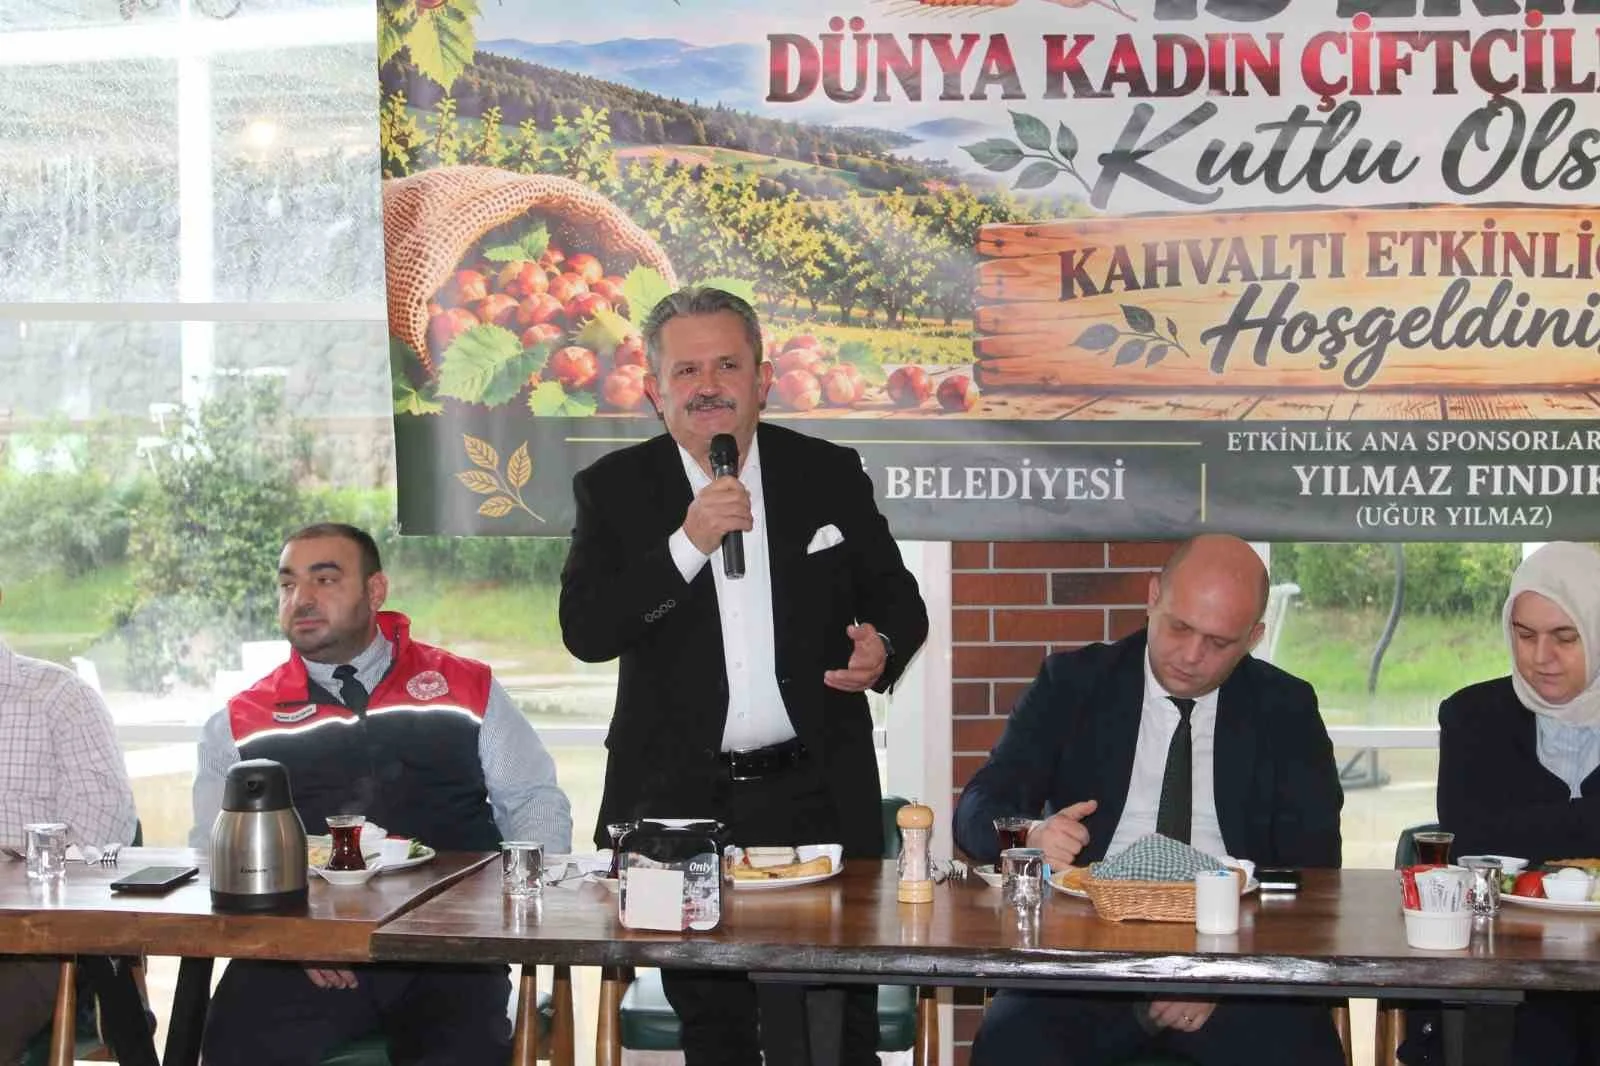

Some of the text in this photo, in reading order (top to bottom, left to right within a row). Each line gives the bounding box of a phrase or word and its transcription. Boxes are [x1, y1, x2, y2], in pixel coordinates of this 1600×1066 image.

[766, 10, 1600, 112] DÜNYA KADIN ÇİFTÇİL
[1090, 99, 1420, 209] Kutlu
[1058, 217, 1600, 300] KAHVALTI ETKİNLİ
[1200, 278, 1600, 388] Hoşgeldini
[1228, 426, 1600, 452] ETKİNLİK ANA SPONSORLAR
[885, 458, 1126, 499] BELEDİYESİ
[1293, 465, 1452, 496] YILMAZ
[1356, 502, 1553, 529] (UĞUR YILMAZ)
